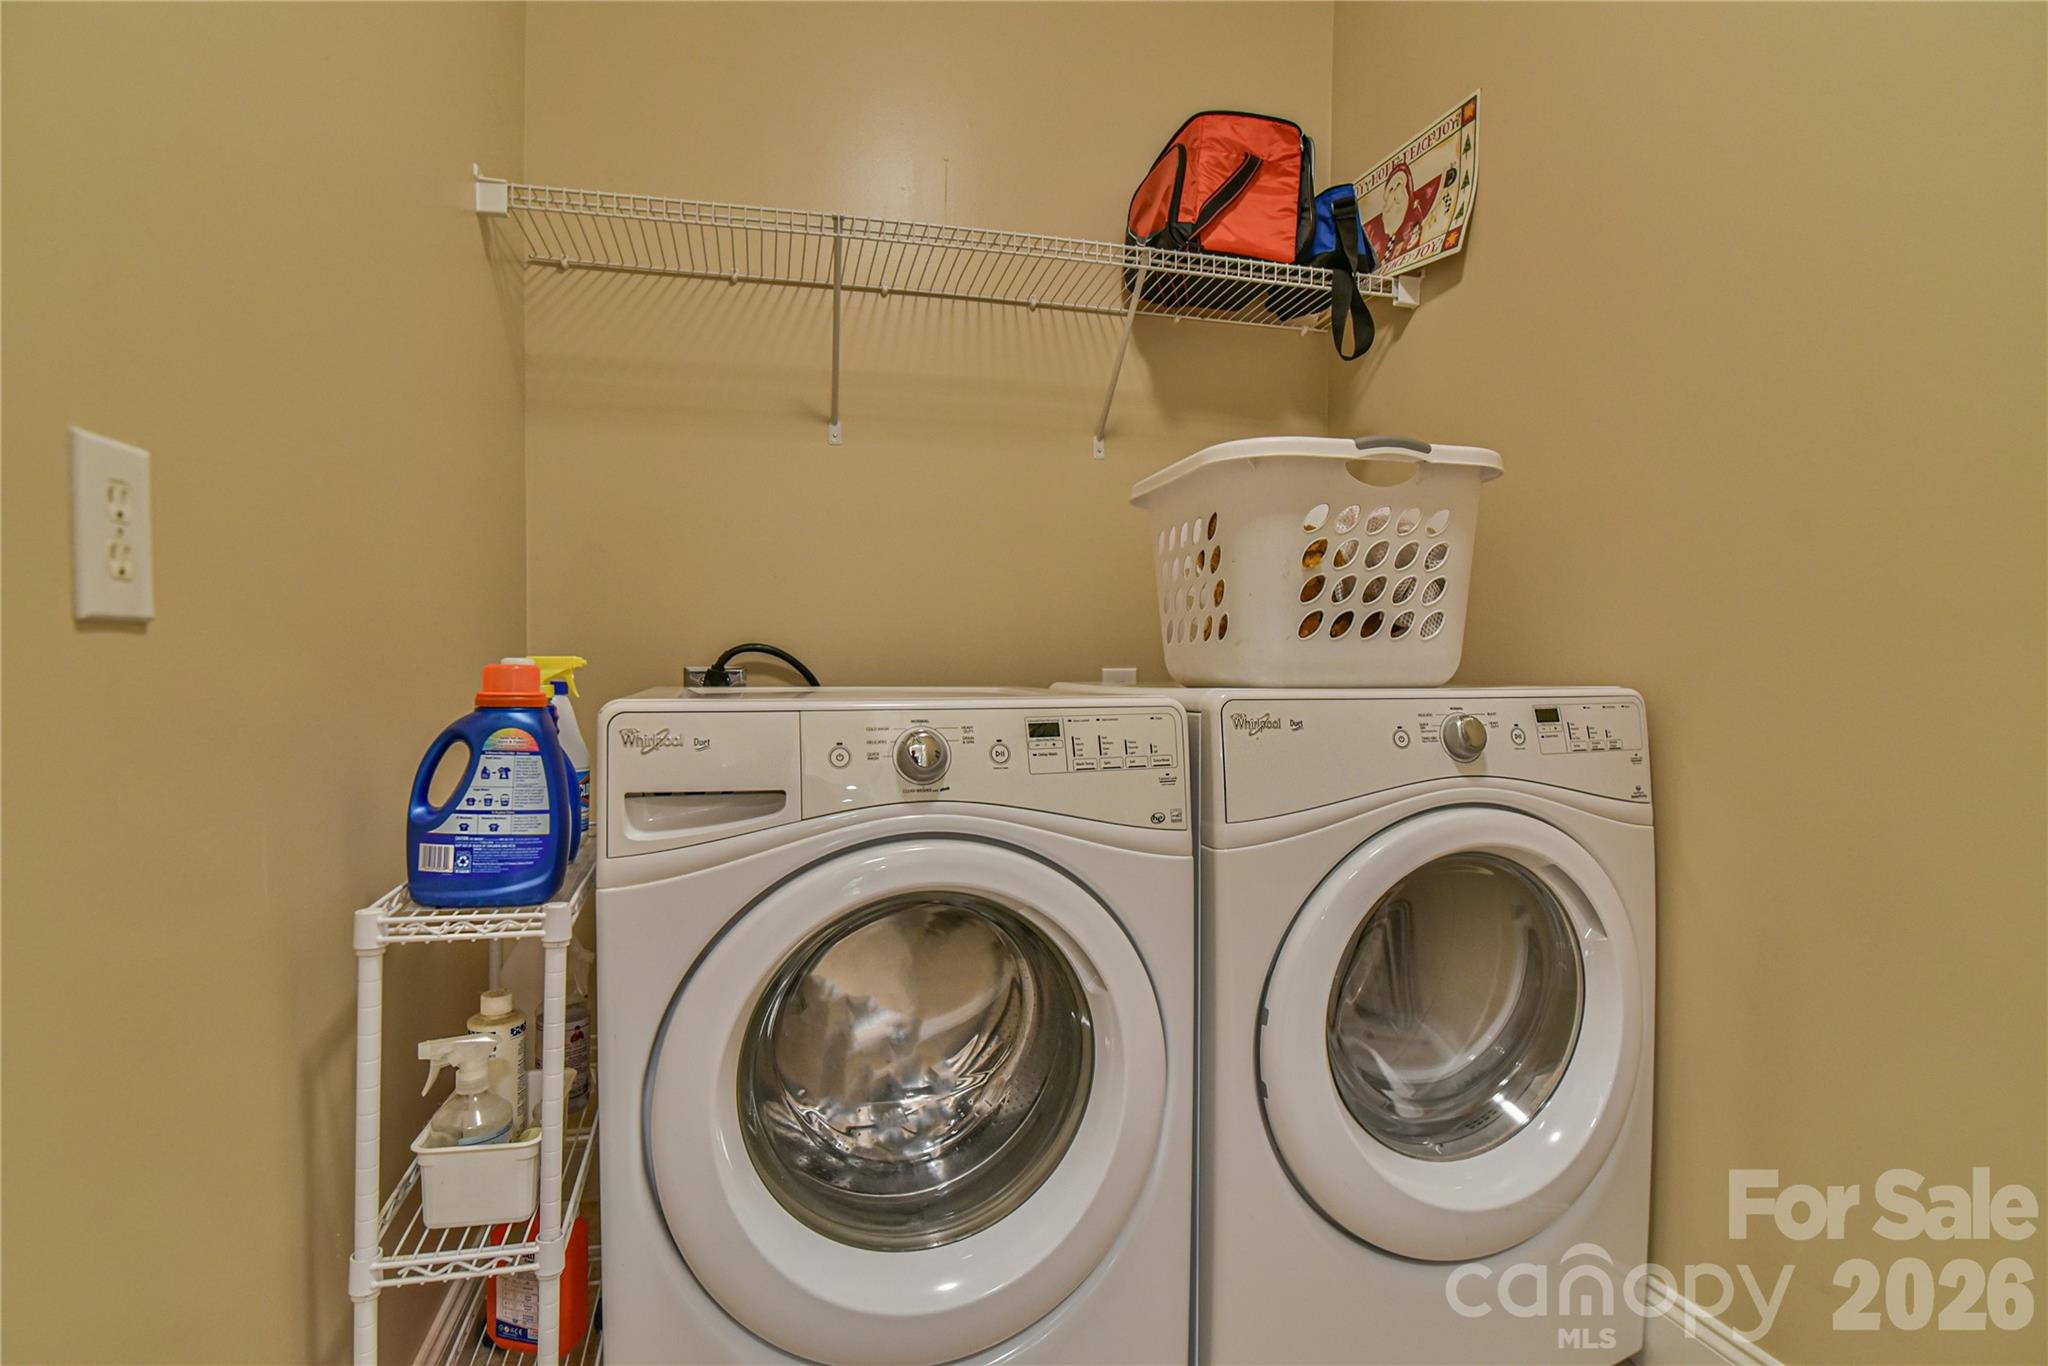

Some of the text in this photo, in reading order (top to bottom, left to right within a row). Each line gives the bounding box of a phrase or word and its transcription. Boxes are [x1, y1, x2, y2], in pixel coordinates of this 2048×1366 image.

[1231, 713, 1304, 733] Whirlpool Duet
[619, 729, 711, 752] Whirlpool Duet
